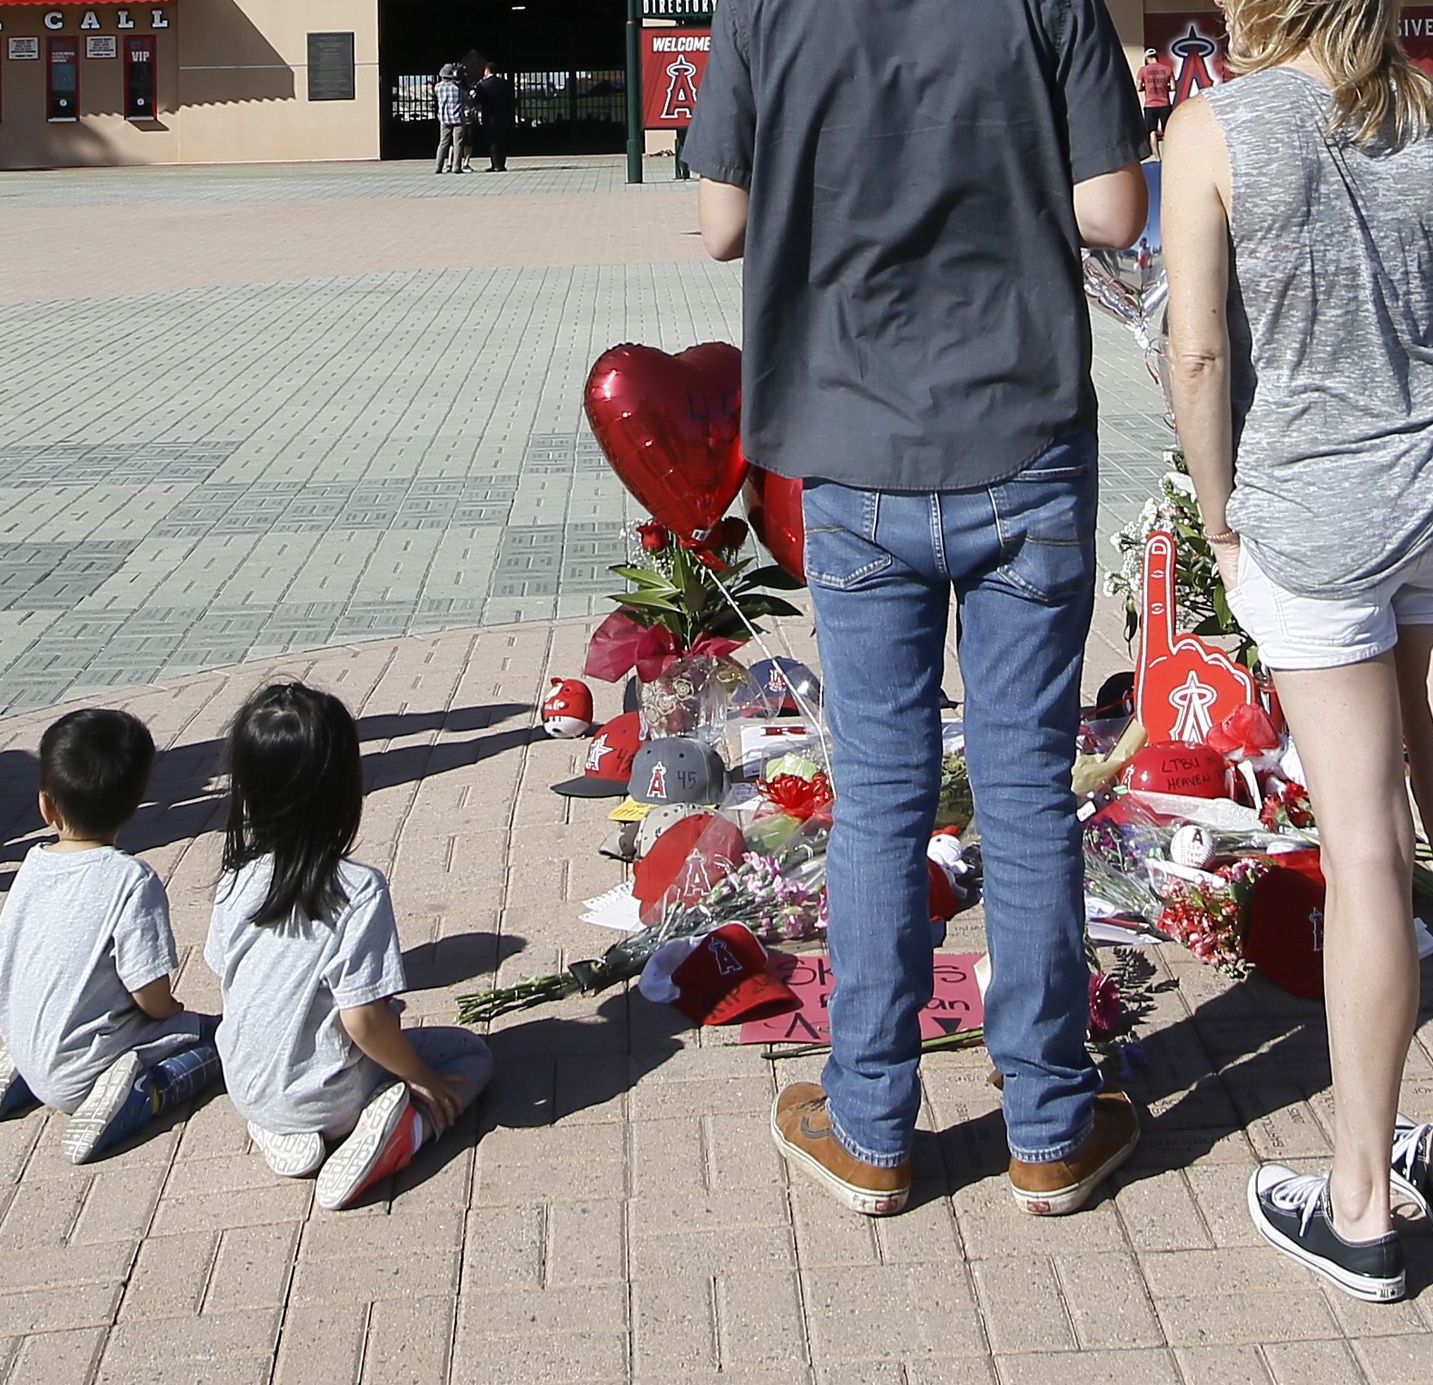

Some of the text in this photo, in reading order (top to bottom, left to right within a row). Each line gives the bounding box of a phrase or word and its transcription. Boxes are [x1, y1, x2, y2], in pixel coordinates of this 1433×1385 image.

[45, 10, 168, 30] CALL
[652, 36, 711, 53] WELCOME
[131, 51, 150, 62] VIP
[677, 770, 698, 790] 45
[1167, 774, 1212, 791] HEAVEN
